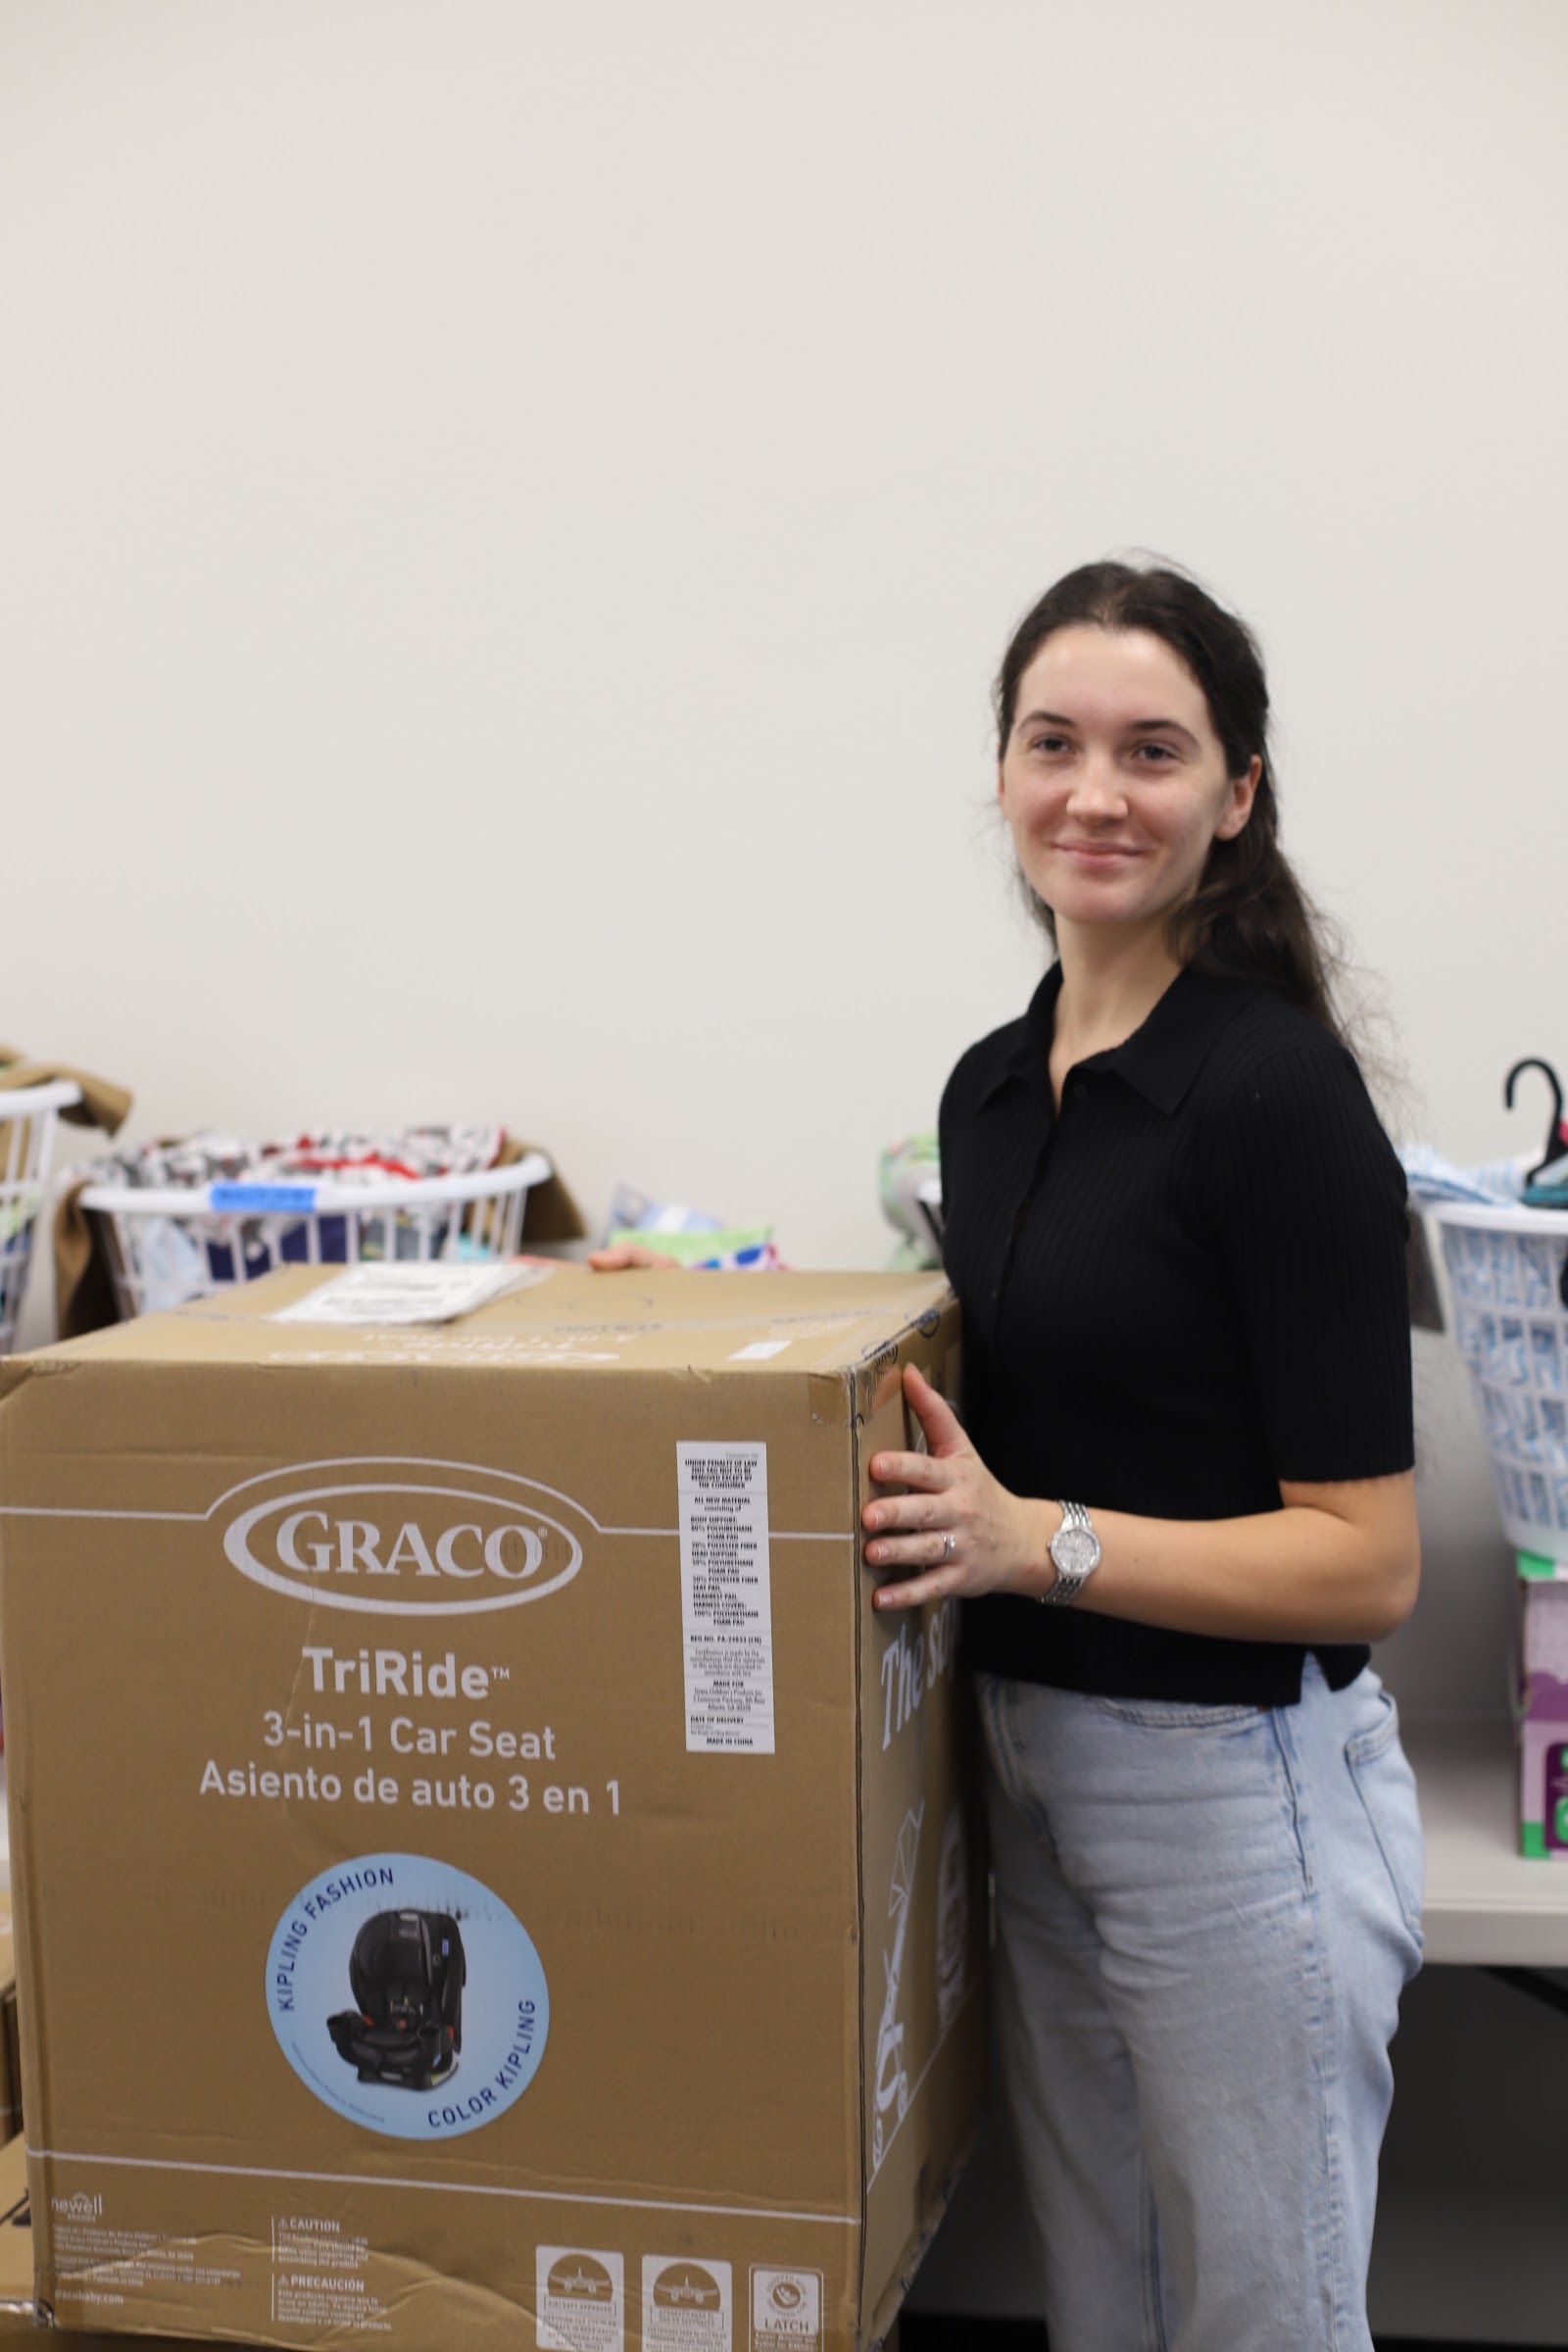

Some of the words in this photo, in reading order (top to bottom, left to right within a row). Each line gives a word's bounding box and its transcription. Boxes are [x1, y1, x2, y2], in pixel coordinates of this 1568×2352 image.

[708, 1558, 754, 1567] POLYURETHANE
[881, 1622, 924, 1751] The
[264, 1710, 373, 1751] 3-in-1
[390, 1717, 457, 1755] Car
[468, 1721, 556, 1760] Seat
[199, 1759, 341, 1801] Asiento
[354, 1768, 399, 1804] de
[412, 1775, 495, 1810] auto
[509, 1774, 529, 1811] 3
[543, 1784, 589, 1814] en
[606, 1780, 619, 1815] 1
[276, 1919, 308, 2013] KIPLING
[304, 1866, 394, 1921] FASHION
[428, 2086, 498, 2129] COLOR
[495, 1999, 535, 2090] KIPLING
[290, 2217, 340, 2233] CAUTION
[291, 2274, 365, 2293] PRECAUCIÓN
[764, 2317, 808, 2332] LATCH
